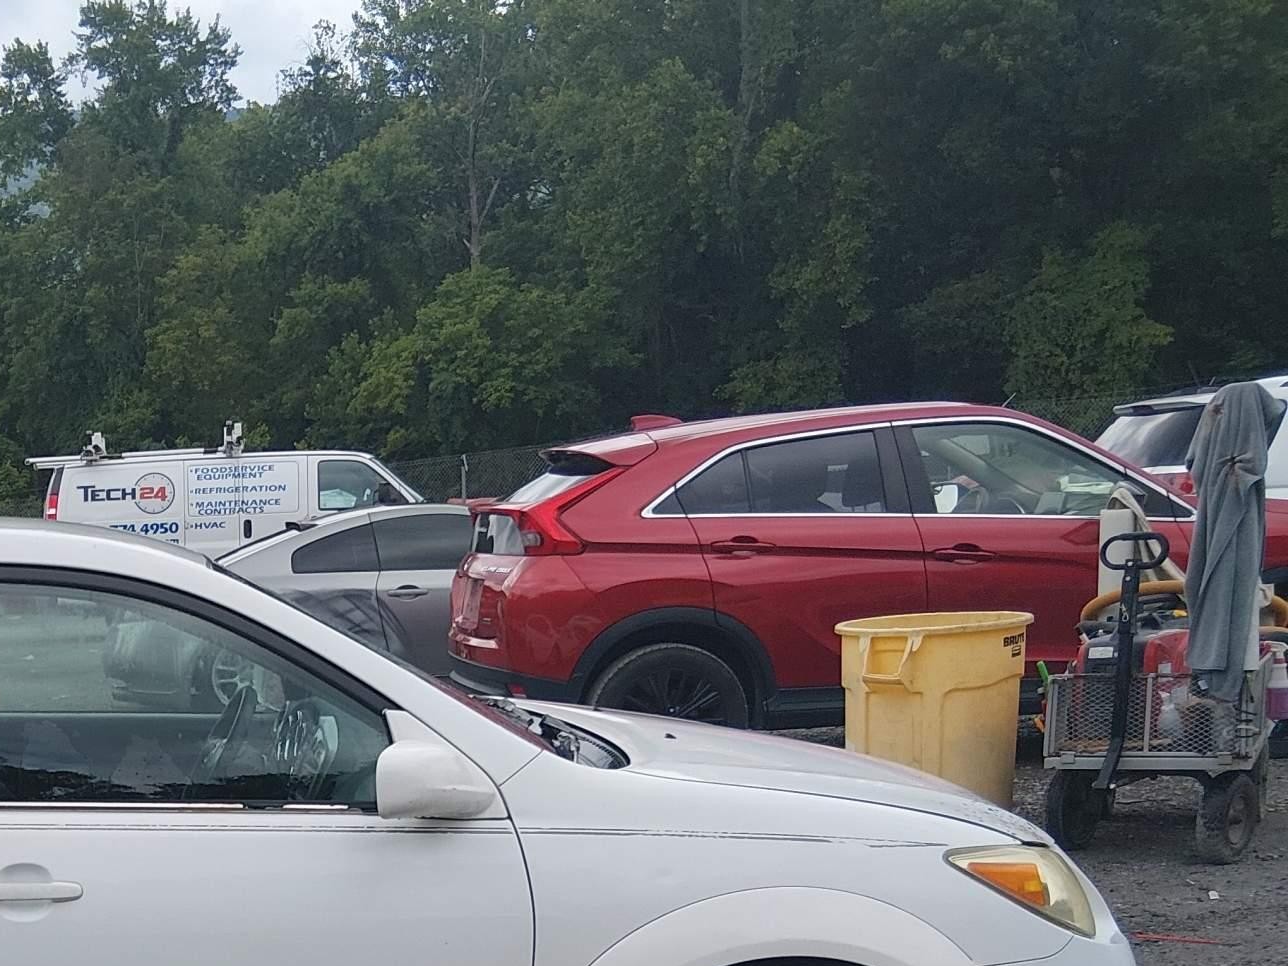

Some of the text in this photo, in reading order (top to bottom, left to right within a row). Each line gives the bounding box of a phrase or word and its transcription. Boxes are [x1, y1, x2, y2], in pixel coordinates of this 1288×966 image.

[194, 464, 275, 475] FOODSERVICE
[196, 472, 264, 481] EQUIPMENT
[194, 484, 287, 495] REFRIGERATION
[195, 498, 281, 509] MAINTENANCE
[198, 506, 265, 516] CONTRACTS
[194, 521, 227, 530] HVAC
